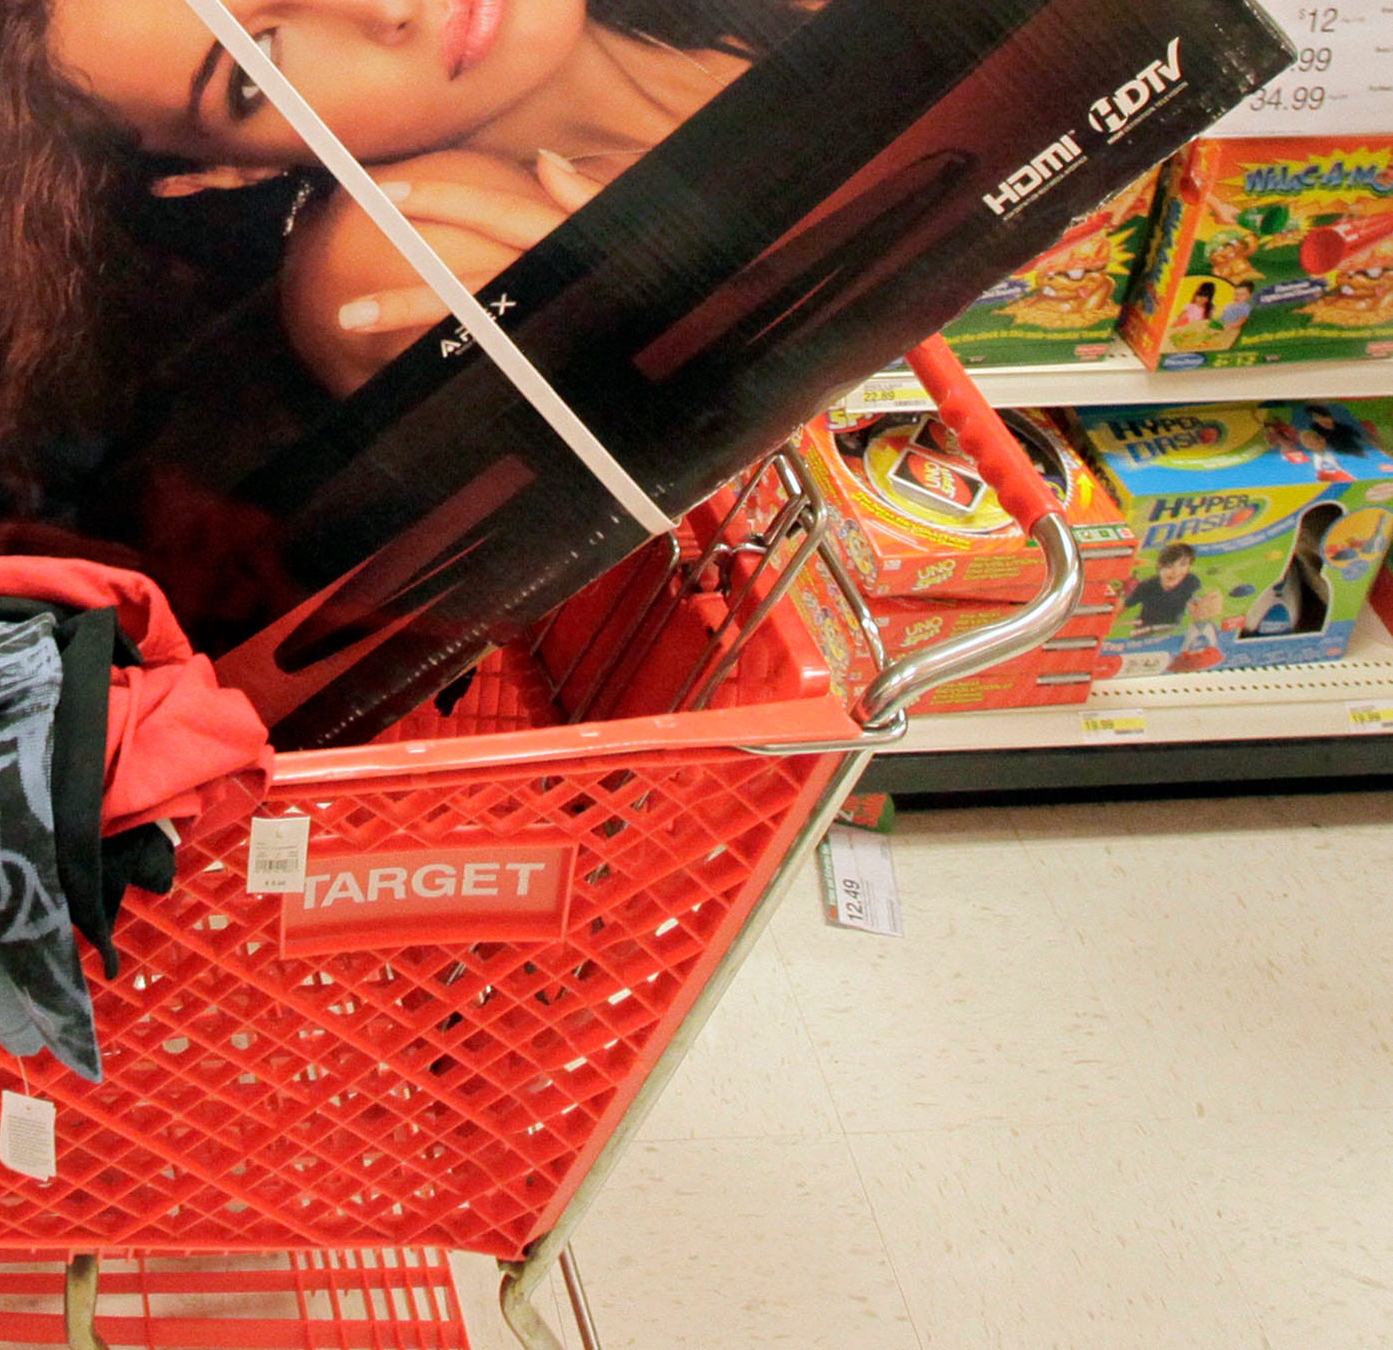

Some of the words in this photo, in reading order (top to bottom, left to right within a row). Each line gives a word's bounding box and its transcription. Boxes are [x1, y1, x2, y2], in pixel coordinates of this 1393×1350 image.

[1298, 7, 1339, 34] $12
[1249, 86, 1326, 112] 34.99
[982, 134, 1084, 216] HDMI
[1106, 415, 1207, 441] HYPER
[1148, 493, 1251, 523] HYPER
[302, 862, 546, 911] TARGET
[842, 878, 864, 922] 12.49
